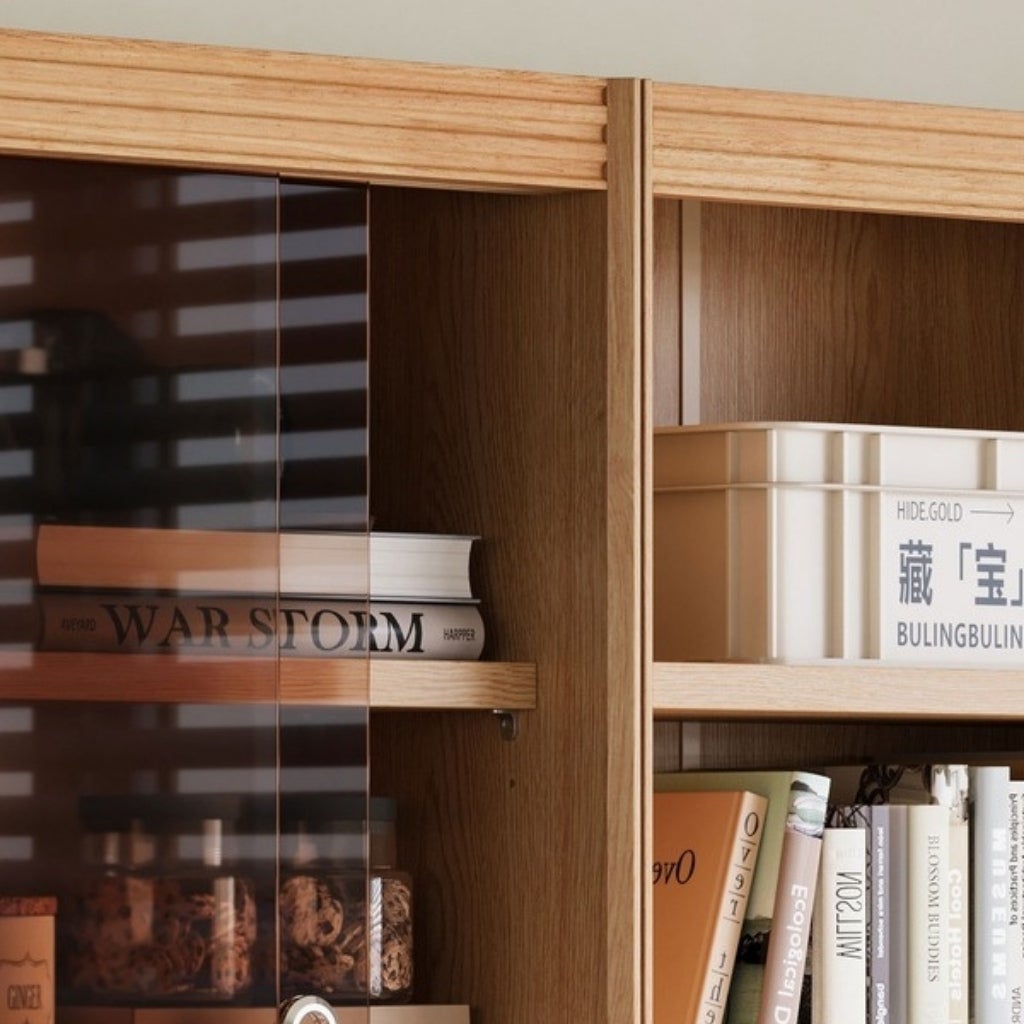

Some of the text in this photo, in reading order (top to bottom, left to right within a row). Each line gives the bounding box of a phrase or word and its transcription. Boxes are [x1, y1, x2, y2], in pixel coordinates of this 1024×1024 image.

[897, 500, 963, 522] HIDE.GOLD
[100, 603, 230, 649] WAR
[248, 607, 425, 653] STORM
[926, 835, 940, 909] BLOSSOM
[926, 912, 940, 983] BUDDIES
